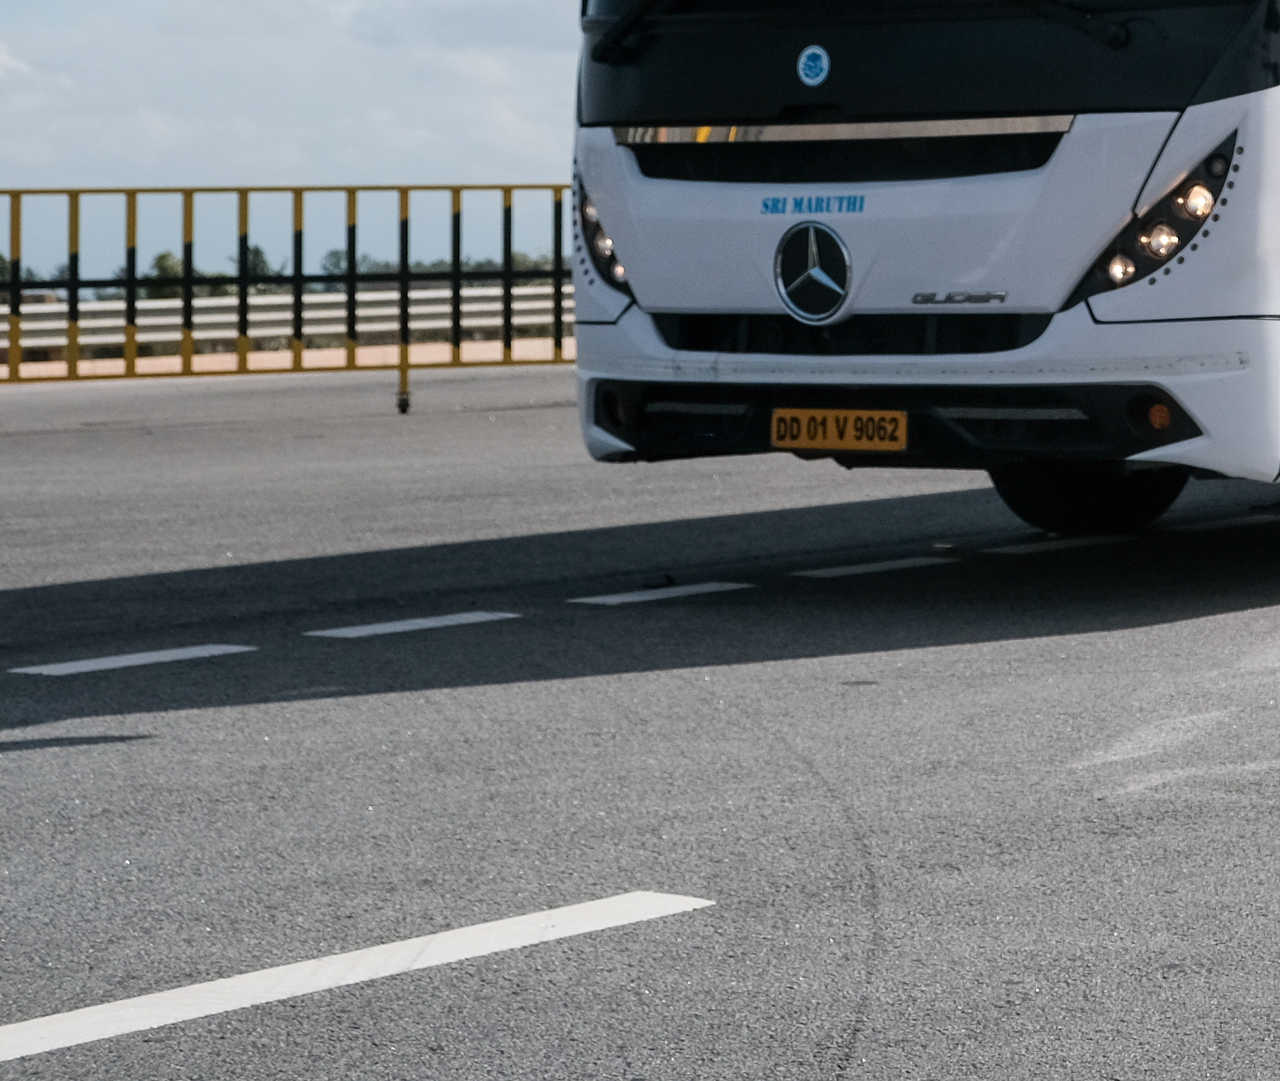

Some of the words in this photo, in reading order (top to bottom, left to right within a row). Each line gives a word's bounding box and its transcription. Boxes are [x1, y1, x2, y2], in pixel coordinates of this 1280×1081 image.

[760, 197, 786, 214] SRI
[791, 195, 865, 213] MARUTHI
[911, 291, 1007, 305] GLIDER
[776, 416, 801, 441] DD
[807, 416, 828, 441] 01
[834, 416, 848, 441] V
[853, 416, 899, 442] 9062
